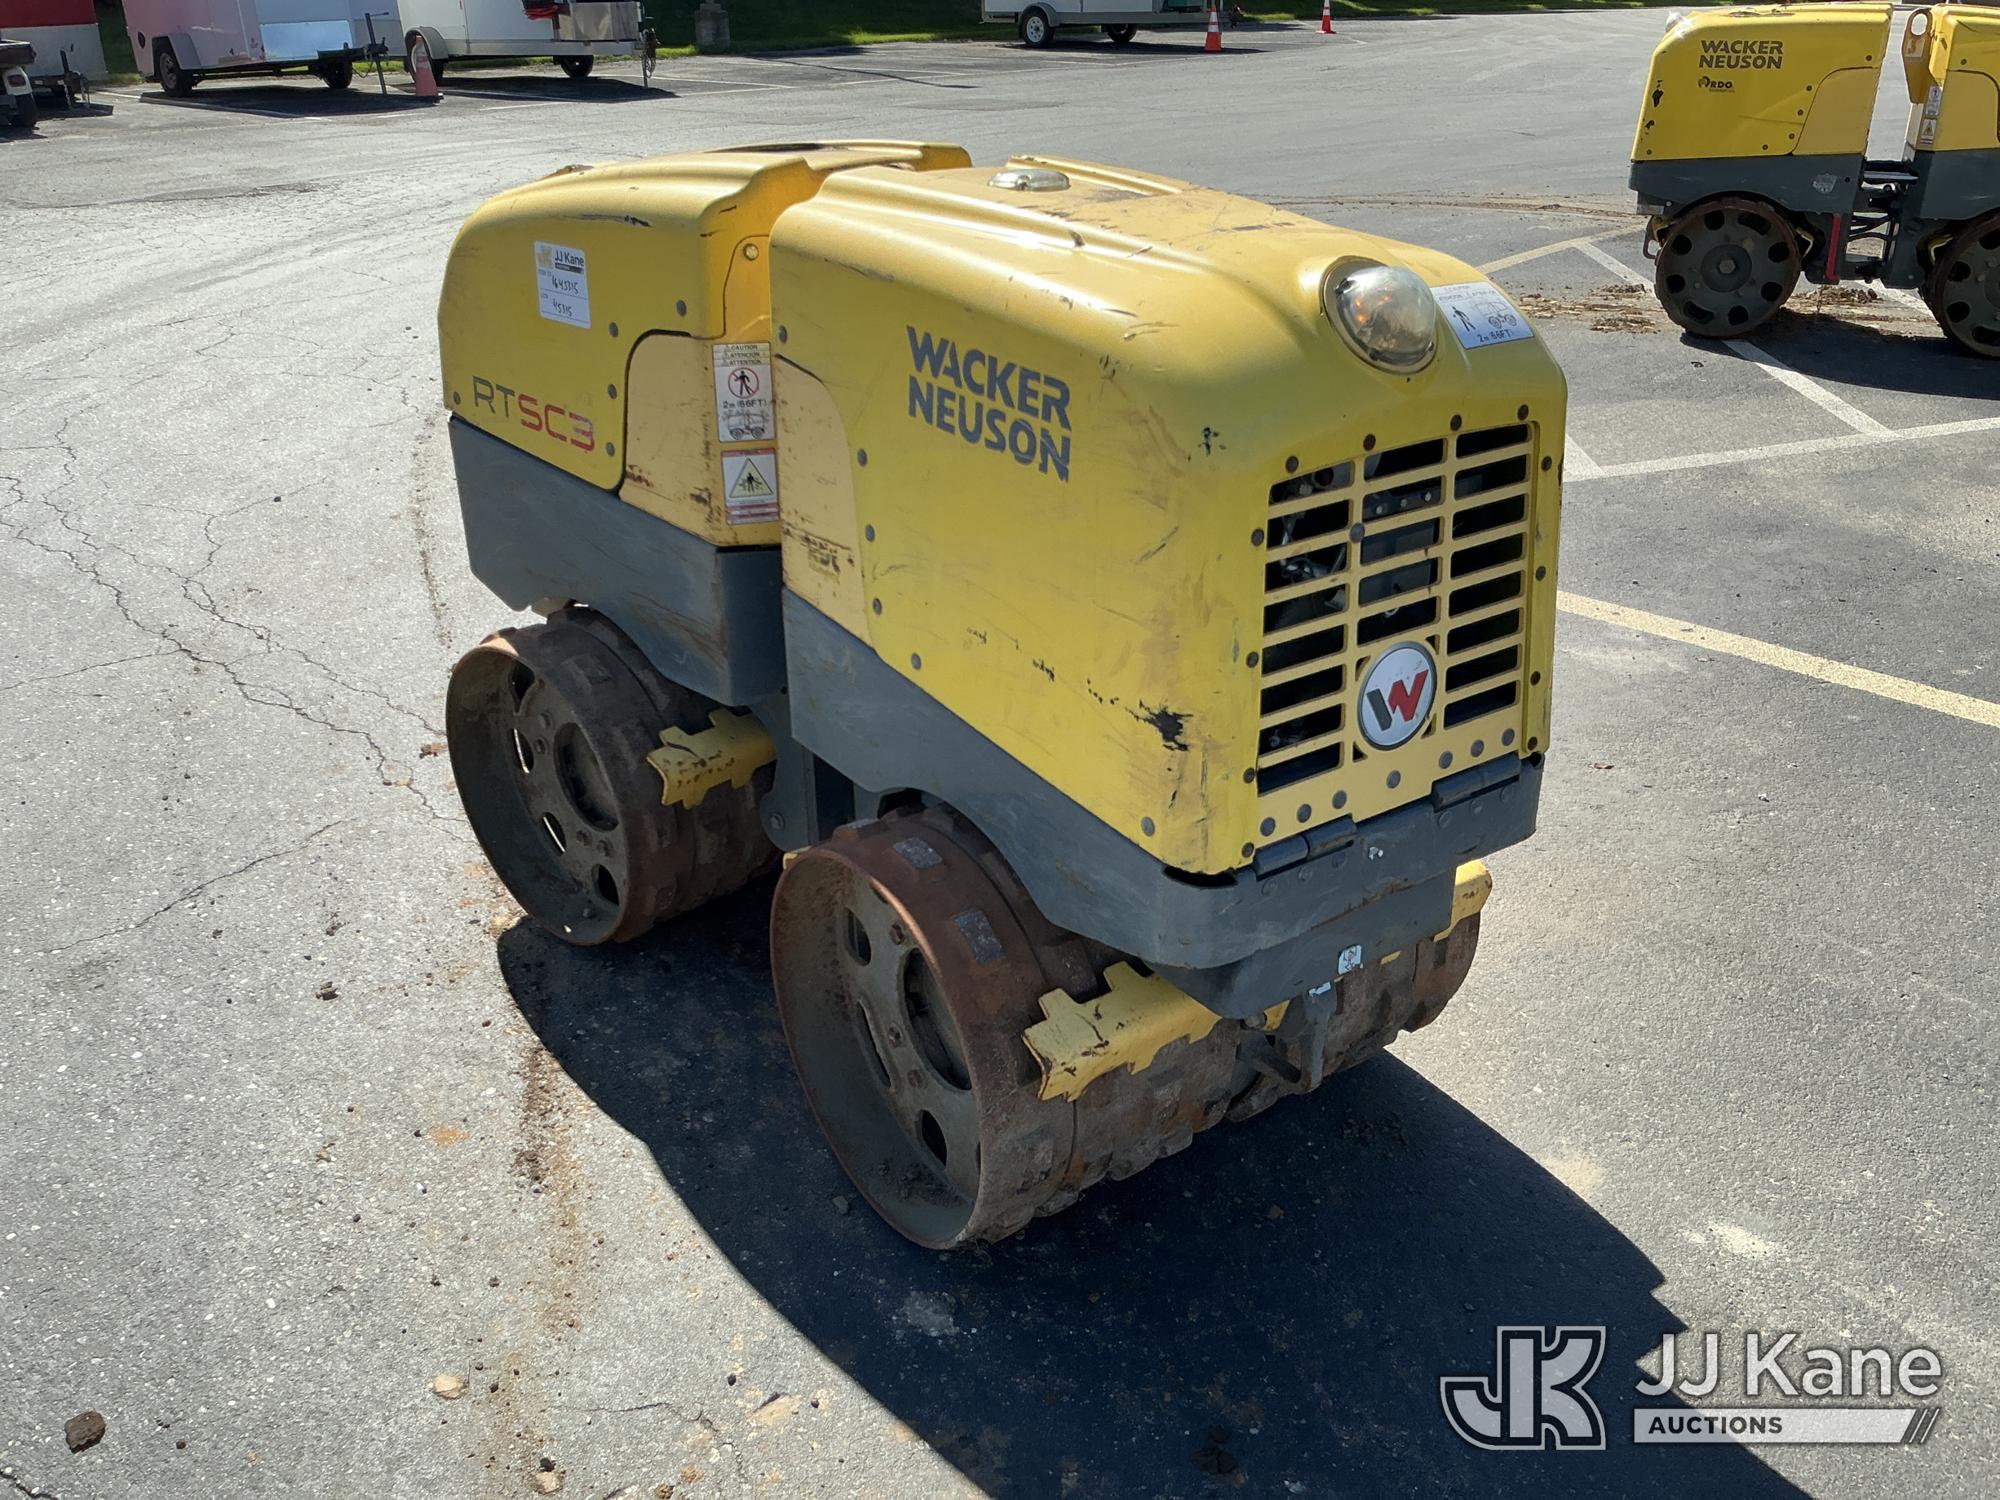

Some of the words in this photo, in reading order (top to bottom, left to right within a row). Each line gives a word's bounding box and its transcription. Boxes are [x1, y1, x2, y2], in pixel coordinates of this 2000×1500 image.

[1700, 39, 1784, 54] WACKER
[1699, 55, 1783, 69] NEUSON
[564, 251, 584, 267] Kane
[906, 324, 1072, 432] WACKER
[908, 374, 1071, 483] NEUSON
